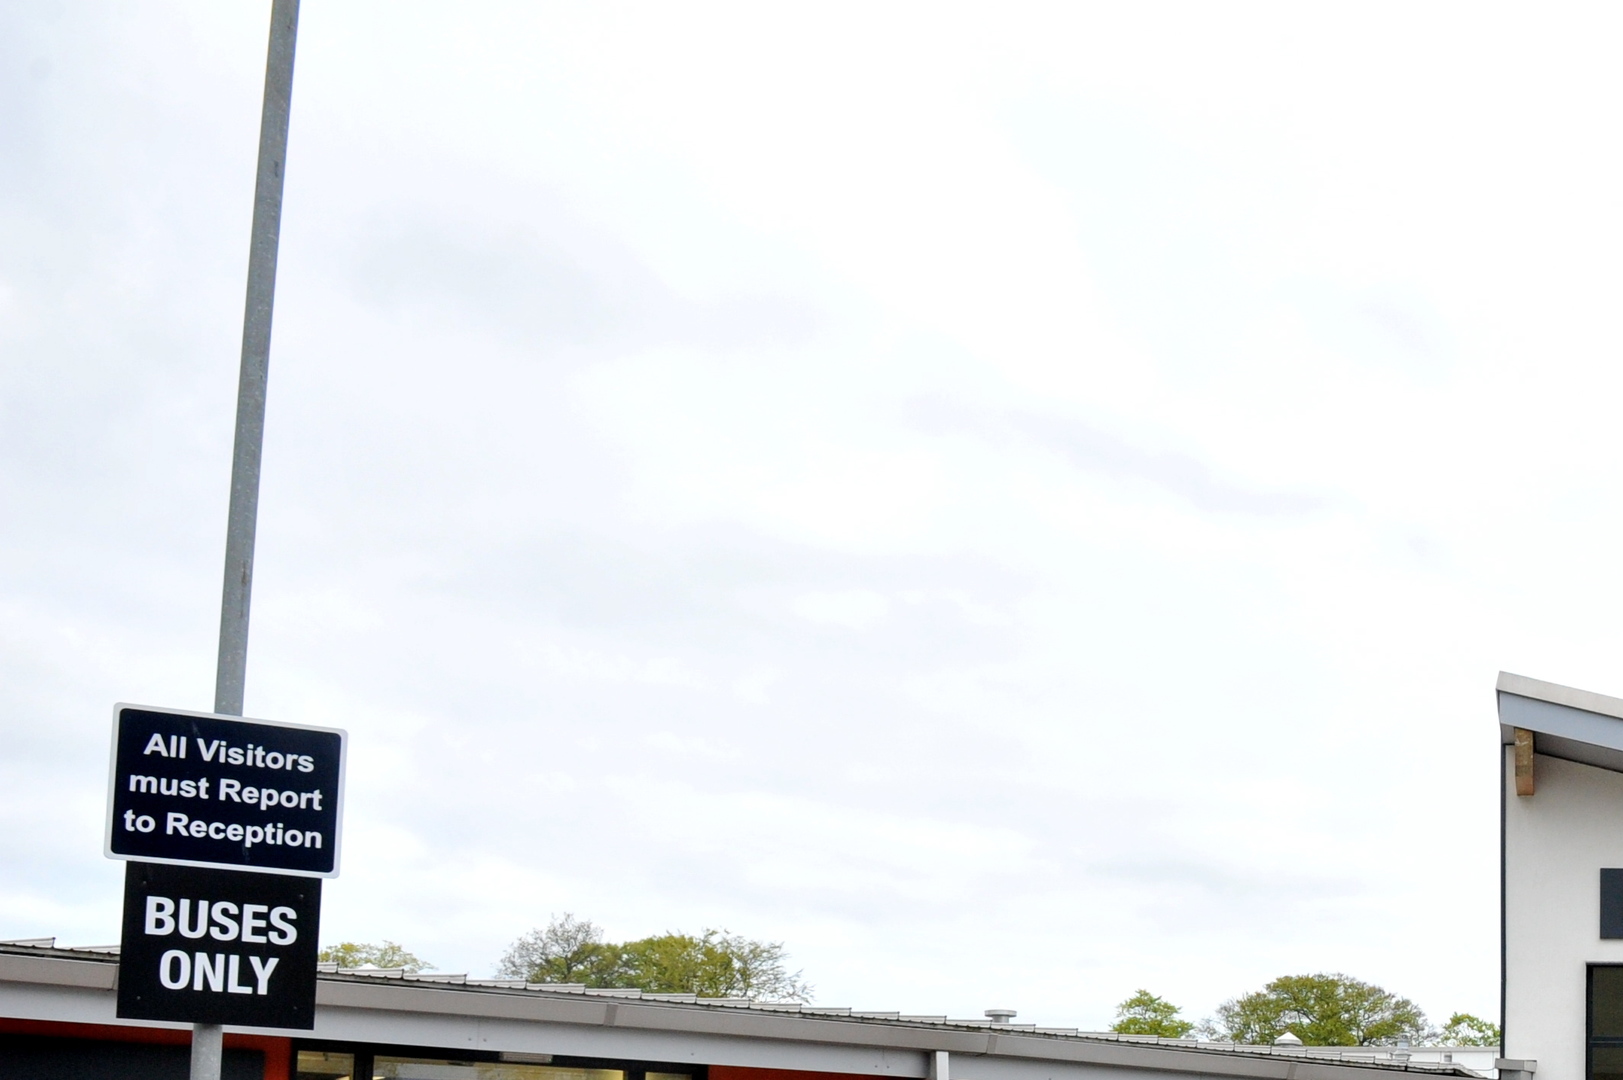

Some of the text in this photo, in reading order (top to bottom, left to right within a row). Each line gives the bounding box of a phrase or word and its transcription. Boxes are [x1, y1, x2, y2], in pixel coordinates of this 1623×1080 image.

[143, 733, 315, 773] All Visitors
[129, 774, 323, 811] must Report
[124, 809, 323, 849] to Reception
[144, 895, 298, 946] BUSES
[159, 949, 280, 996] ONLY
